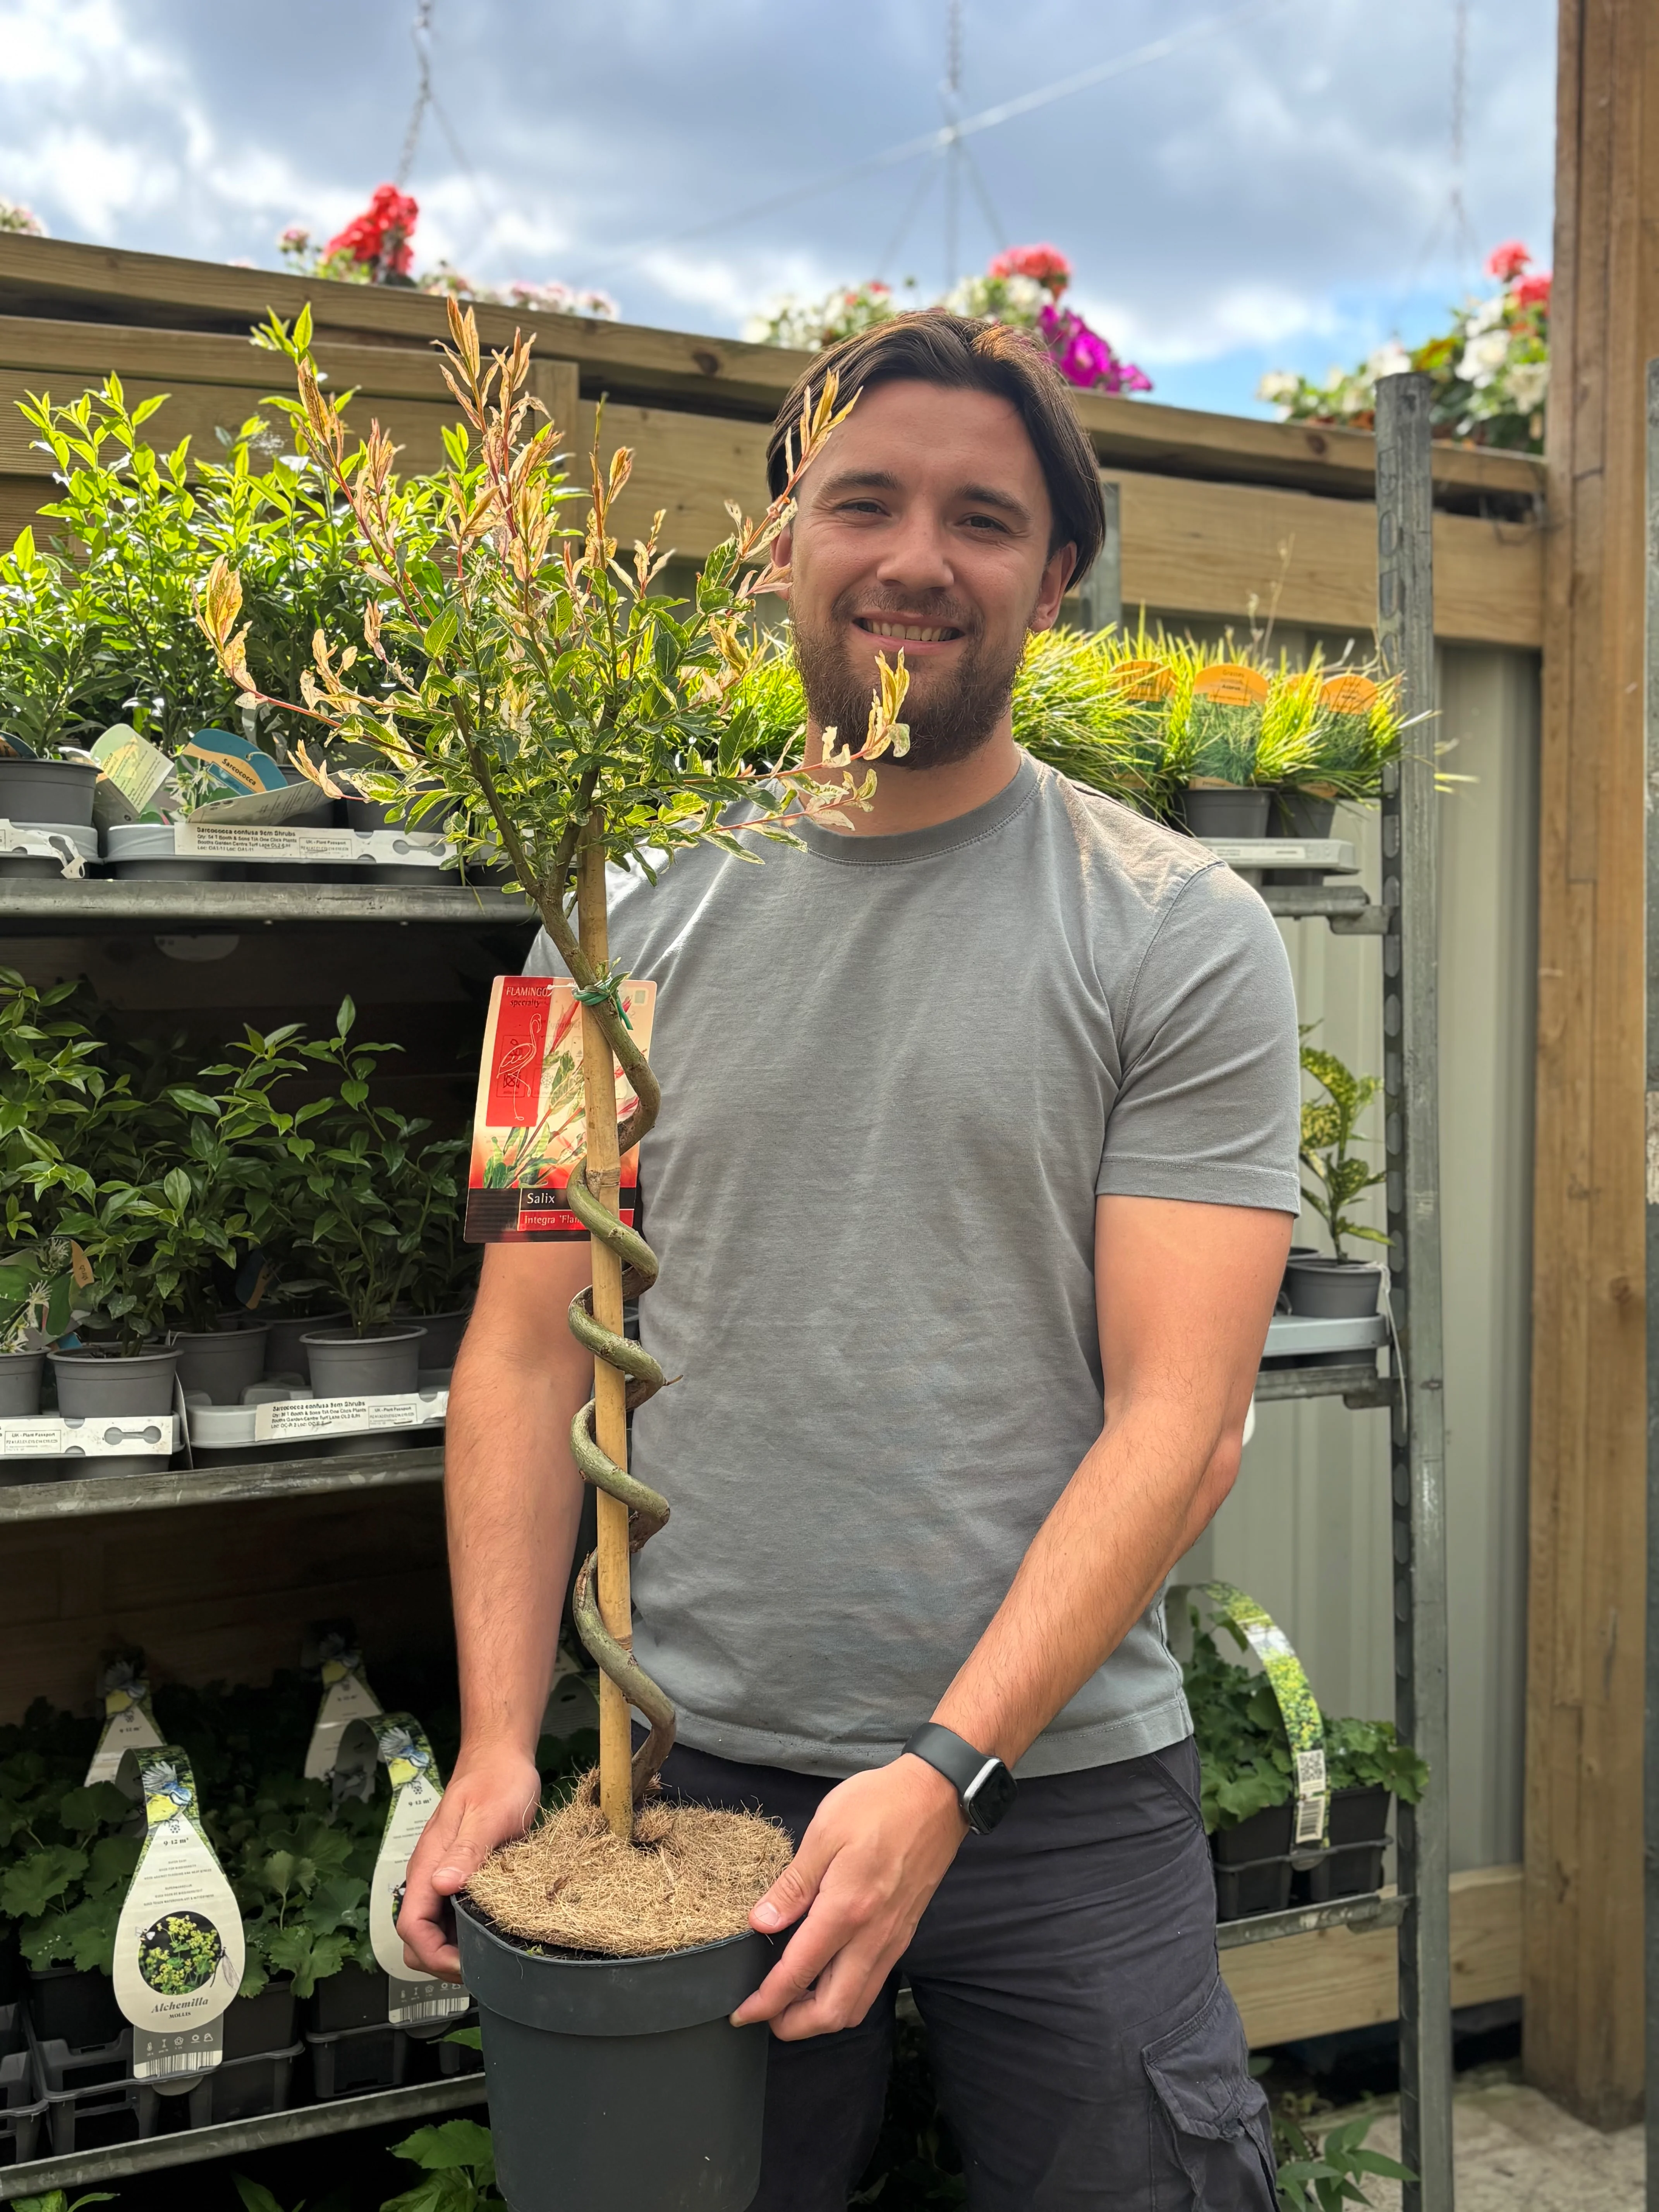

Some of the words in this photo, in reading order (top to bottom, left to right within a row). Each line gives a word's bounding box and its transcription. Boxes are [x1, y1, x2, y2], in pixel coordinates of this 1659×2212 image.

[222, 758, 256, 786] Sarcococca
[506, 986, 548, 997] FLAMINGO
[510, 998, 541, 1008] specialty
[527, 1192, 555, 1204] Salix
[524, 1215, 555, 1226] integra
[151, 1997, 209, 2013] Alchemilla
